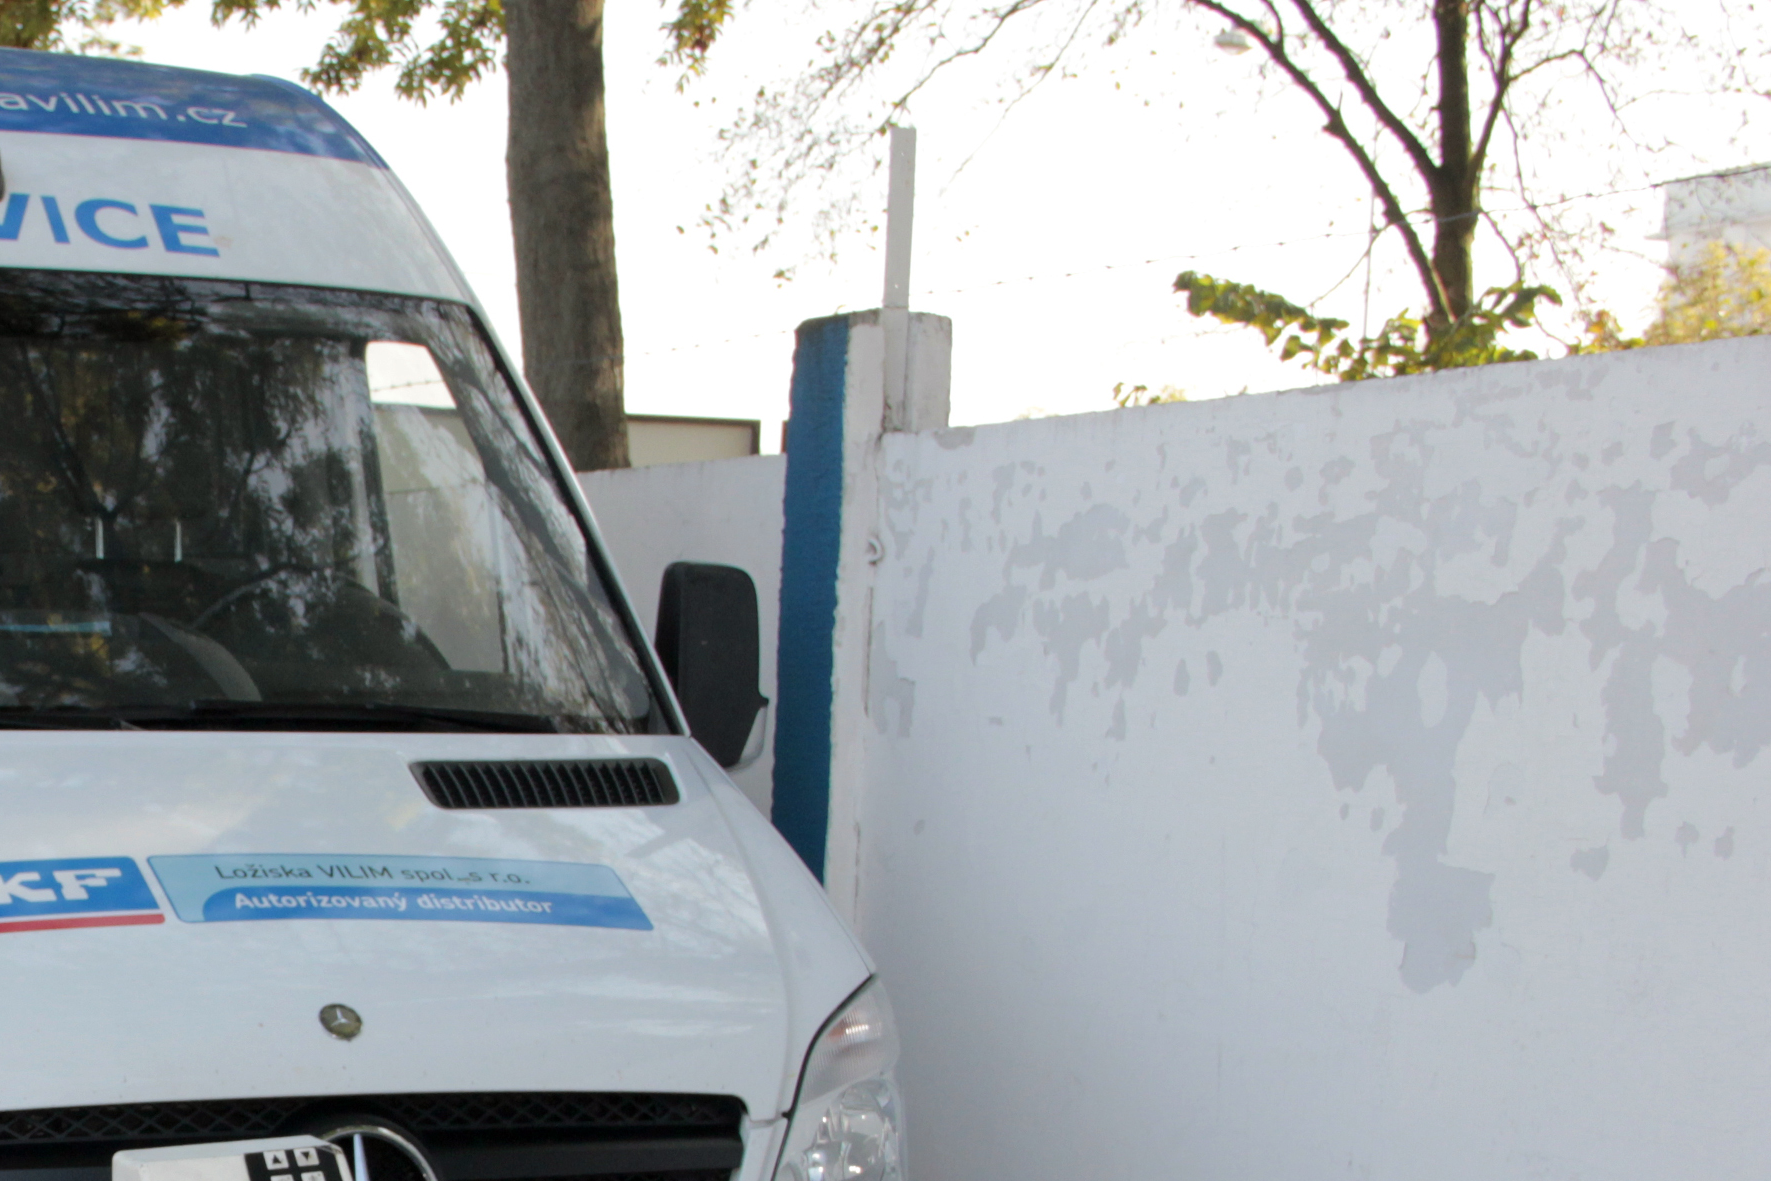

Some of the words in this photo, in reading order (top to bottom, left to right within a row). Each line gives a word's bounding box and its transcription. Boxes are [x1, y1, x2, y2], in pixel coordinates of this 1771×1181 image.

[215, 863, 312, 880] Ložiska
[317, 864, 393, 881] VILIM
[469, 871, 482, 883] s
[490, 871, 531, 885] r.o.
[234, 891, 407, 912] Autorizovaný
[416, 892, 554, 914] distributor
